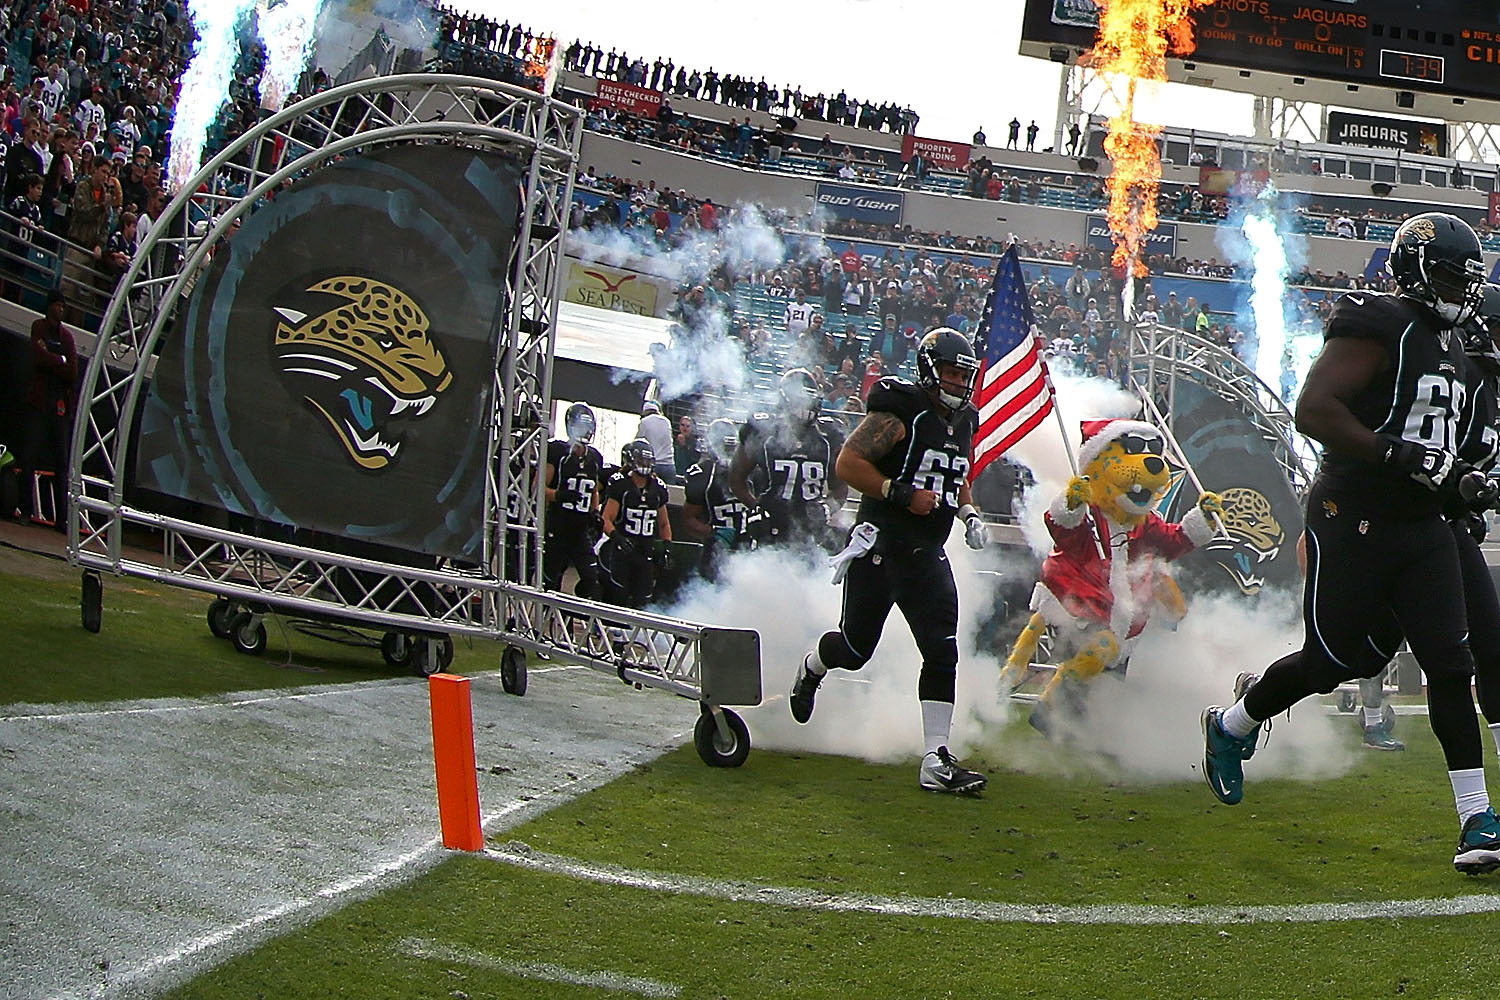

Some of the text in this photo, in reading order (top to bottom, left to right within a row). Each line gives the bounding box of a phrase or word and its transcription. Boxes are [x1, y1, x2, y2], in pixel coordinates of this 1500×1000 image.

[1293, 7, 1368, 28] JAGUARS
[1474, 31, 1493, 42] NFL
[1401, 55, 1441, 79] 7:39
[42, 90, 57, 109] 83
[600, 93, 636, 106] BAG FREE
[601, 85, 660, 104] FIRST CHECKED
[89, 110, 101, 124] 12
[1339, 124, 1409, 145] JAGUARS
[913, 142, 953, 153] PRIORITY
[819, 195, 899, 211] BUD LIGHT
[1089, 227, 1112, 237] BU
[577, 287, 606, 308] SEA
[770, 286, 783, 297] 87
[793, 309, 805, 321] 21
[685, 463, 703, 476] 57
[912, 449, 970, 509] 63
[774, 459, 825, 501] 78
[624, 508, 658, 537] 56
[713, 504, 750, 534] 57
